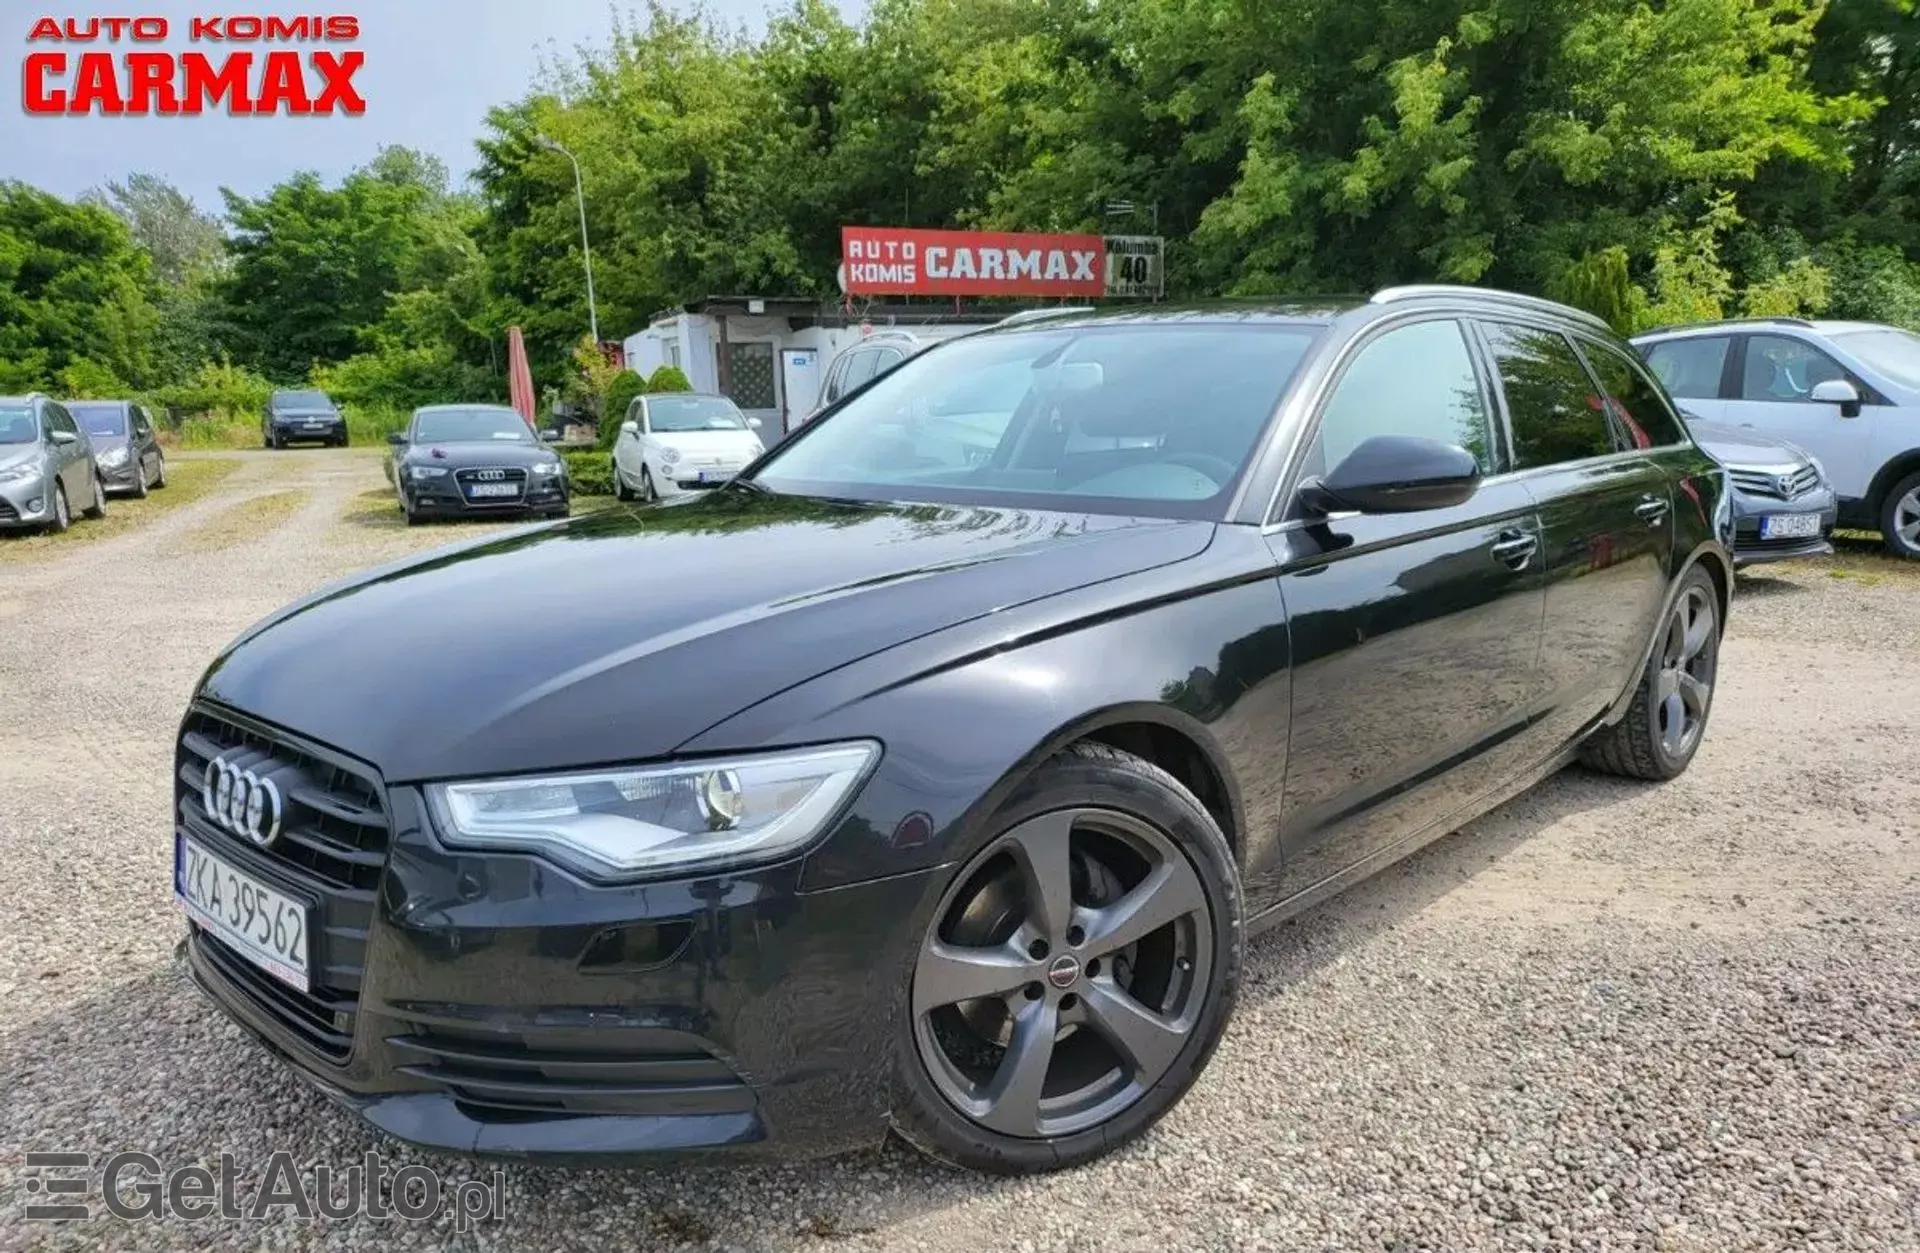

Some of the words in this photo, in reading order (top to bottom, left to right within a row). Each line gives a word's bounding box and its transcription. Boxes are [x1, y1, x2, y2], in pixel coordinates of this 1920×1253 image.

[849, 240, 915, 260] AUTO
[925, 246, 1095, 281] CARMAX
[850, 263, 916, 283] KOMIS
[1120, 256, 1147, 283] 40
[187, 845, 222, 917] ZKA
[229, 874, 304, 966] 39562
